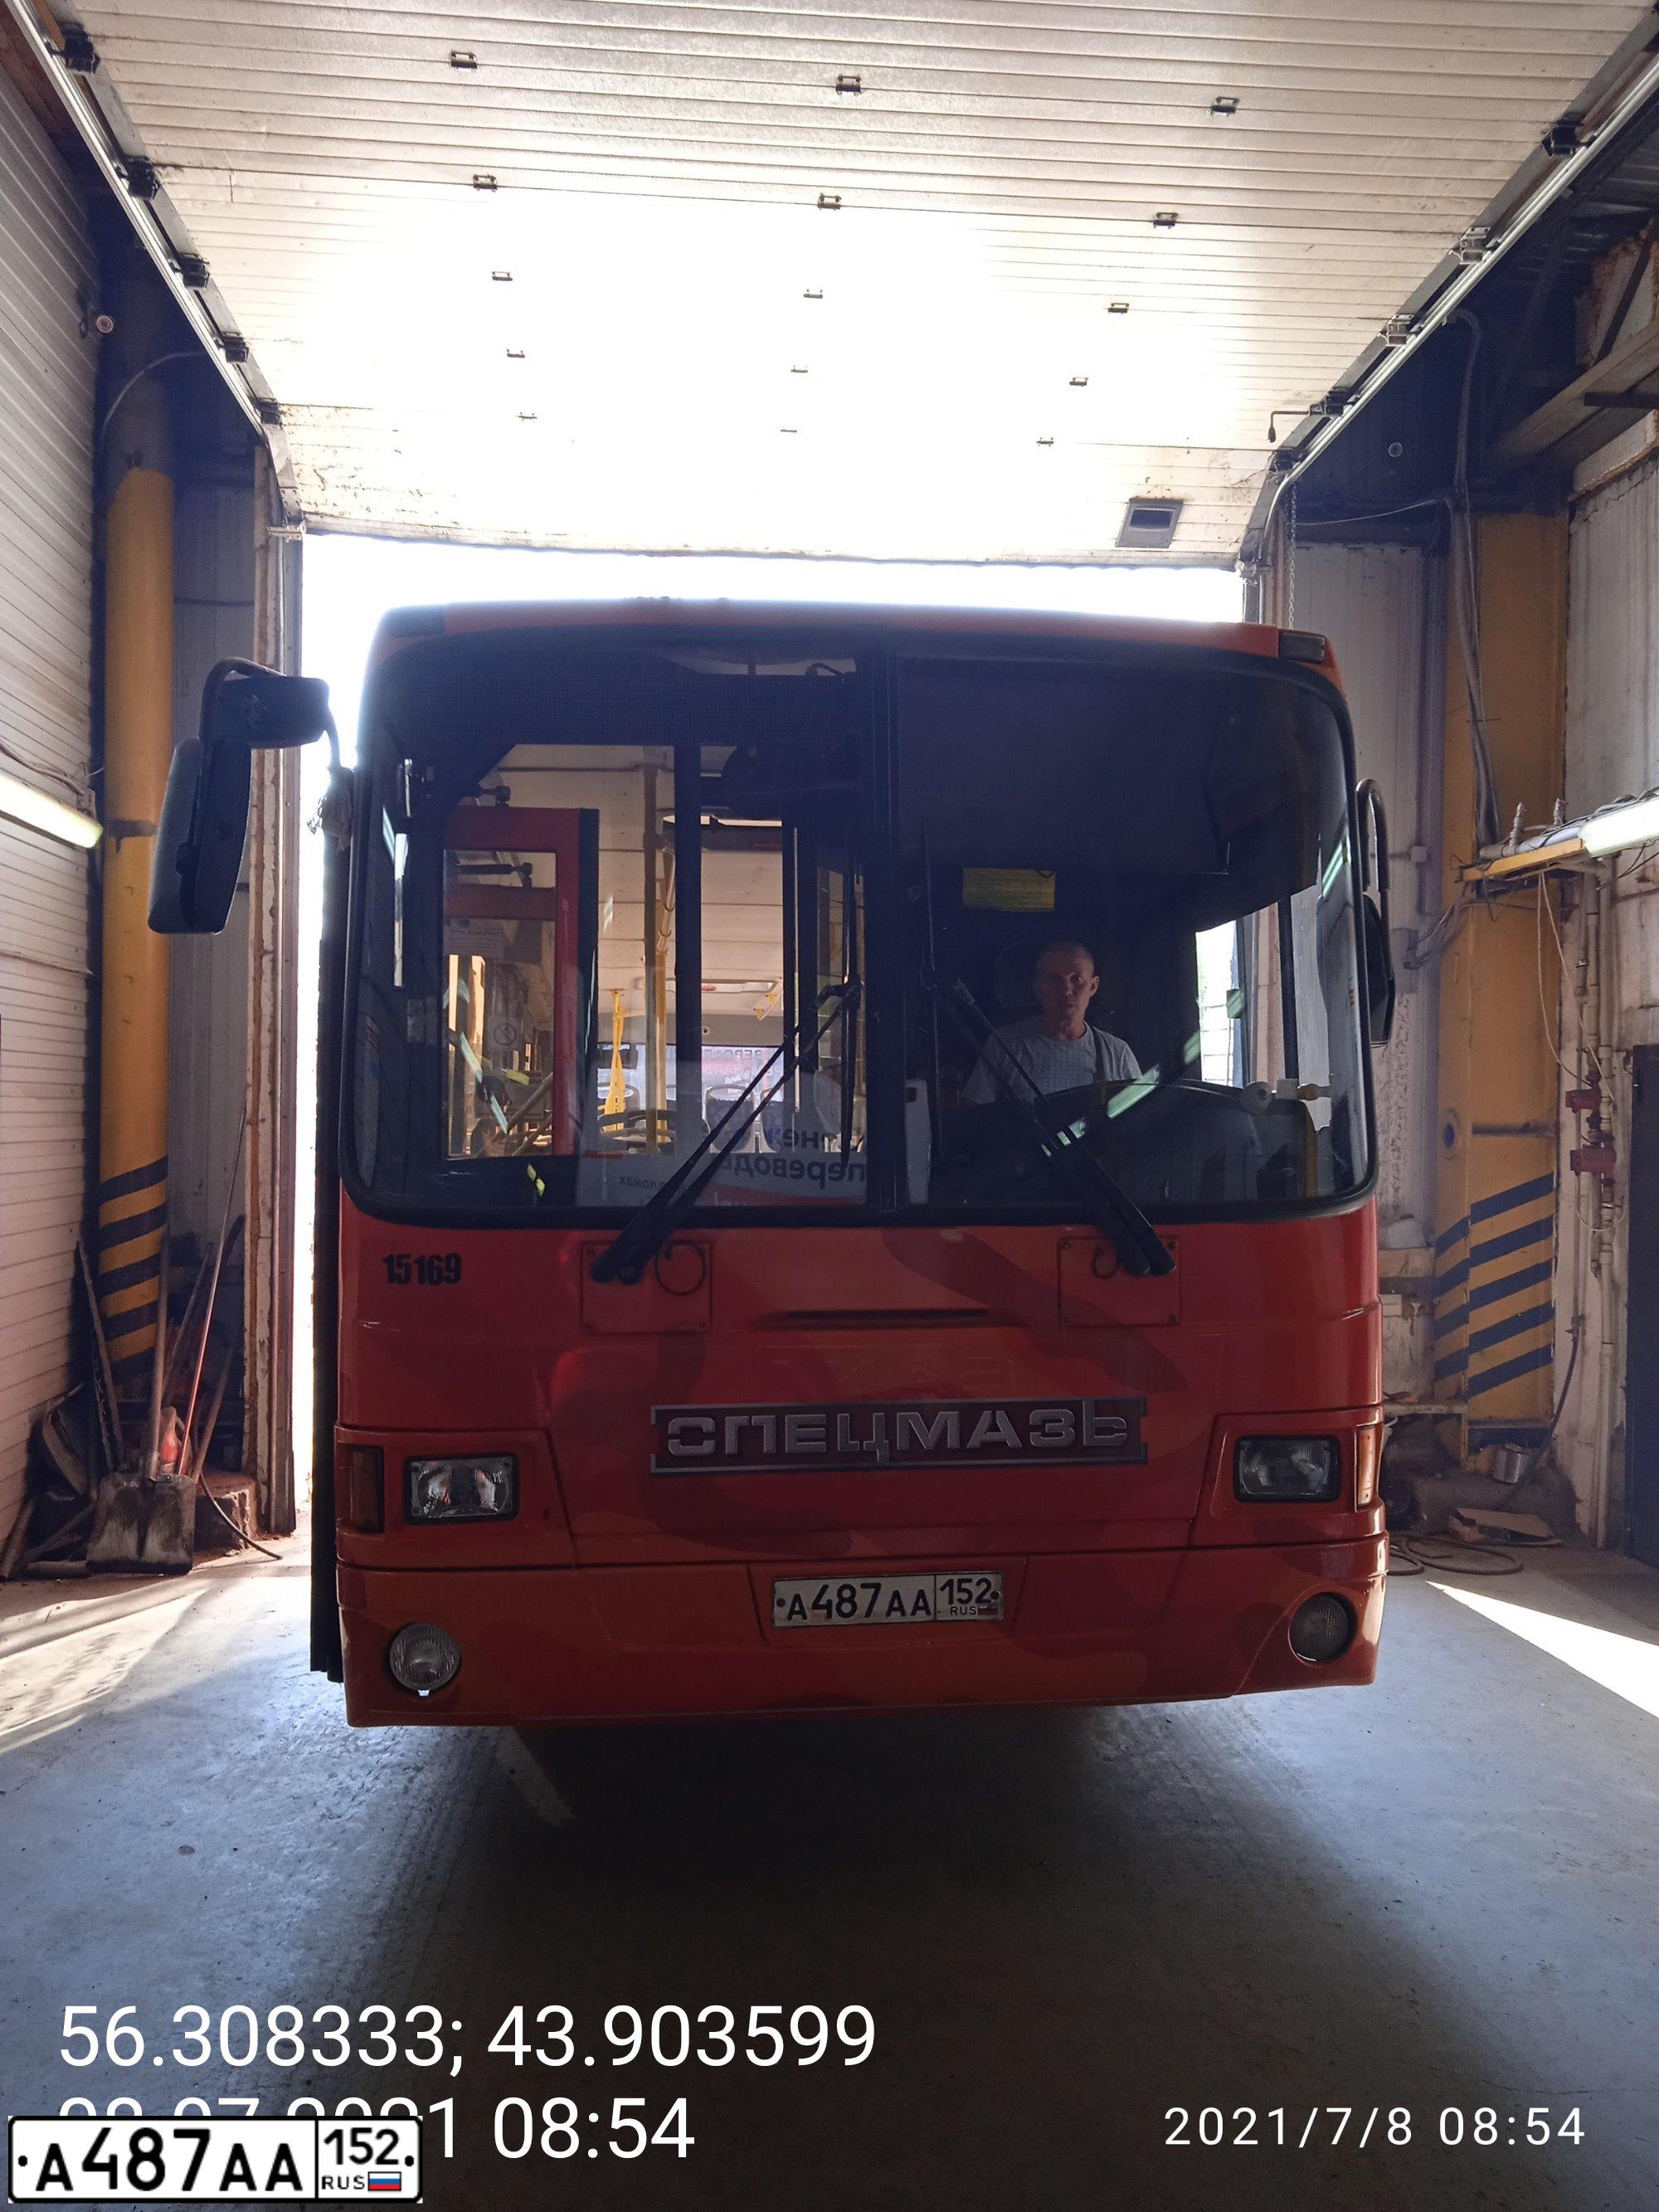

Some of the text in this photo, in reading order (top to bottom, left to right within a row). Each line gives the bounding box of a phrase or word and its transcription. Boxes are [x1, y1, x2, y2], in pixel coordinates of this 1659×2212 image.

[383, 1253, 462, 1286] 15169
[668, 1401, 1128, 1464] СПЕЦМАЗЬ
[939, 1577, 992, 1605] 152
[950, 1605, 977, 1616] RUS
